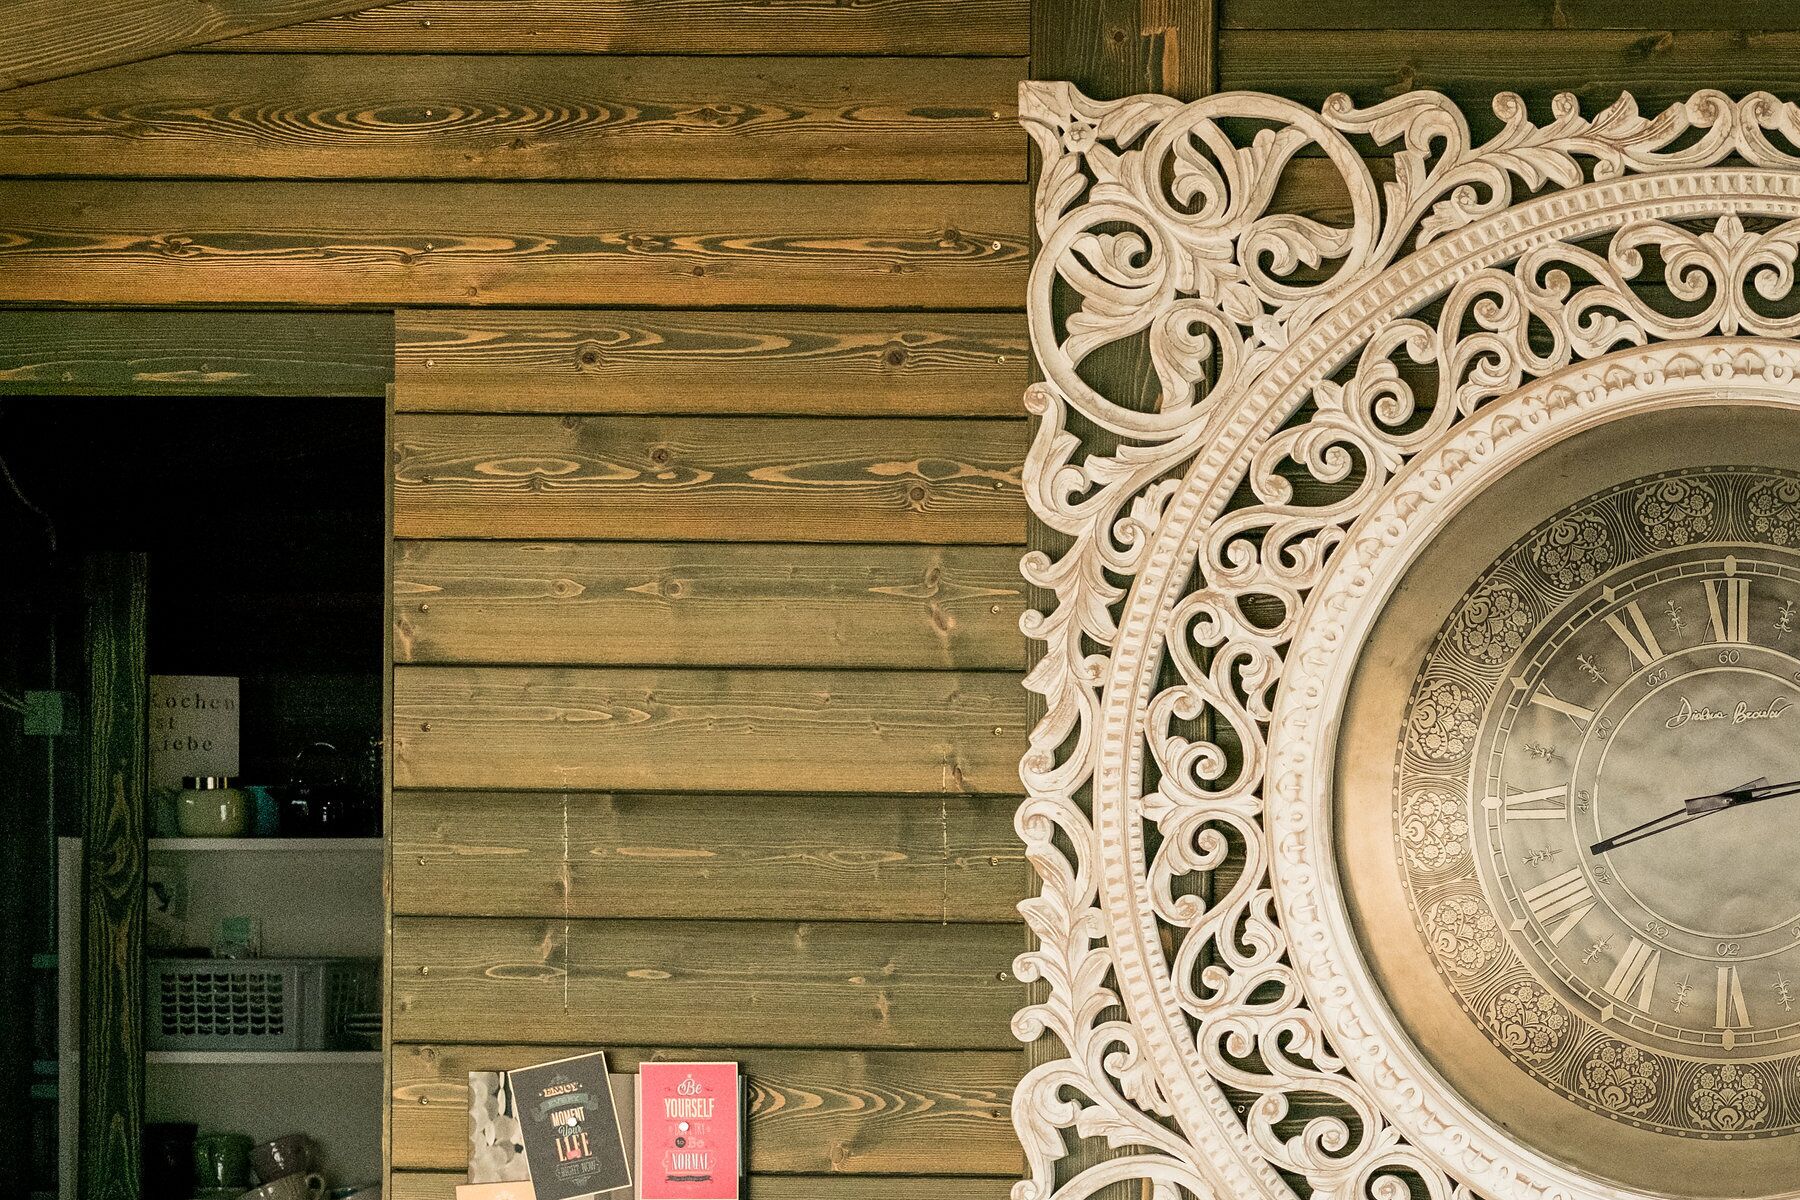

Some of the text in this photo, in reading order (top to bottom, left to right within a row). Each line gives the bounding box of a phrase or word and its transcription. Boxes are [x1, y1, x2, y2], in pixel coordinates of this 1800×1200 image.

[1700, 578, 1752, 644] XII
[1601, 598, 1667, 677] XI
[1717, 649, 1741, 665] 60
[1646, 667, 1669, 687] 55
[1527, 678, 1598, 736] X
[1594, 715, 1613, 741] 50
[156, 735, 213, 751] iebe
[1505, 782, 1569, 824] IX
[1576, 789, 1590, 814] 45
[1593, 865, 1612, 886] 40
[1520, 865, 1598, 948] VIII
[1644, 920, 1670, 940] 35
[1716, 942, 1740, 956] 30
[1600, 934, 1661, 1015] VII
[1712, 965, 1754, 1029] VI
[677, 1078, 702, 1096] Be
[664, 1097, 715, 1118] YOURSELF
[671, 1152, 710, 1170] NORMAL
